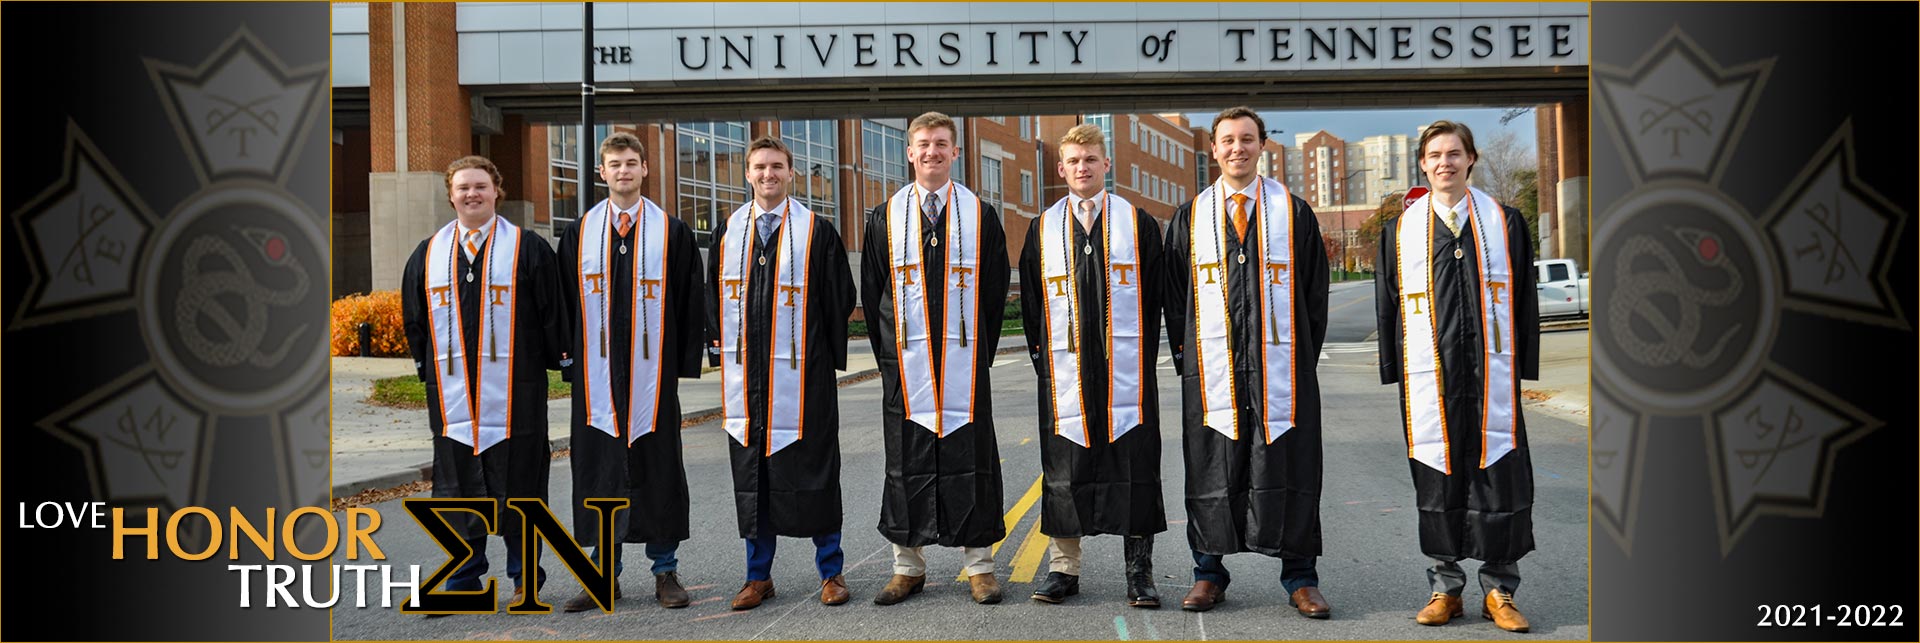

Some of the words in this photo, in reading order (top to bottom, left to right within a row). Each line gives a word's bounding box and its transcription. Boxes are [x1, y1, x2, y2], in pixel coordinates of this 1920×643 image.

[677, 30, 1089, 70] UNIVERSITY
[1141, 30, 1176, 62] of
[1226, 25, 1574, 62] TENNESSEE
[586, 274, 604, 294] T
[897, 264, 917, 285] T
[951, 266, 972, 288] T
[1112, 264, 1133, 285] T
[1200, 262, 1220, 285] T
[1266, 263, 1287, 285] T
[432, 286, 450, 307] T
[489, 284, 509, 305] T
[640, 279, 660, 299] T
[725, 279, 743, 300] T
[780, 285, 801, 307] T
[1048, 275, 1069, 297] T
[1487, 281, 1506, 304] T
[1407, 292, 1427, 315] T
